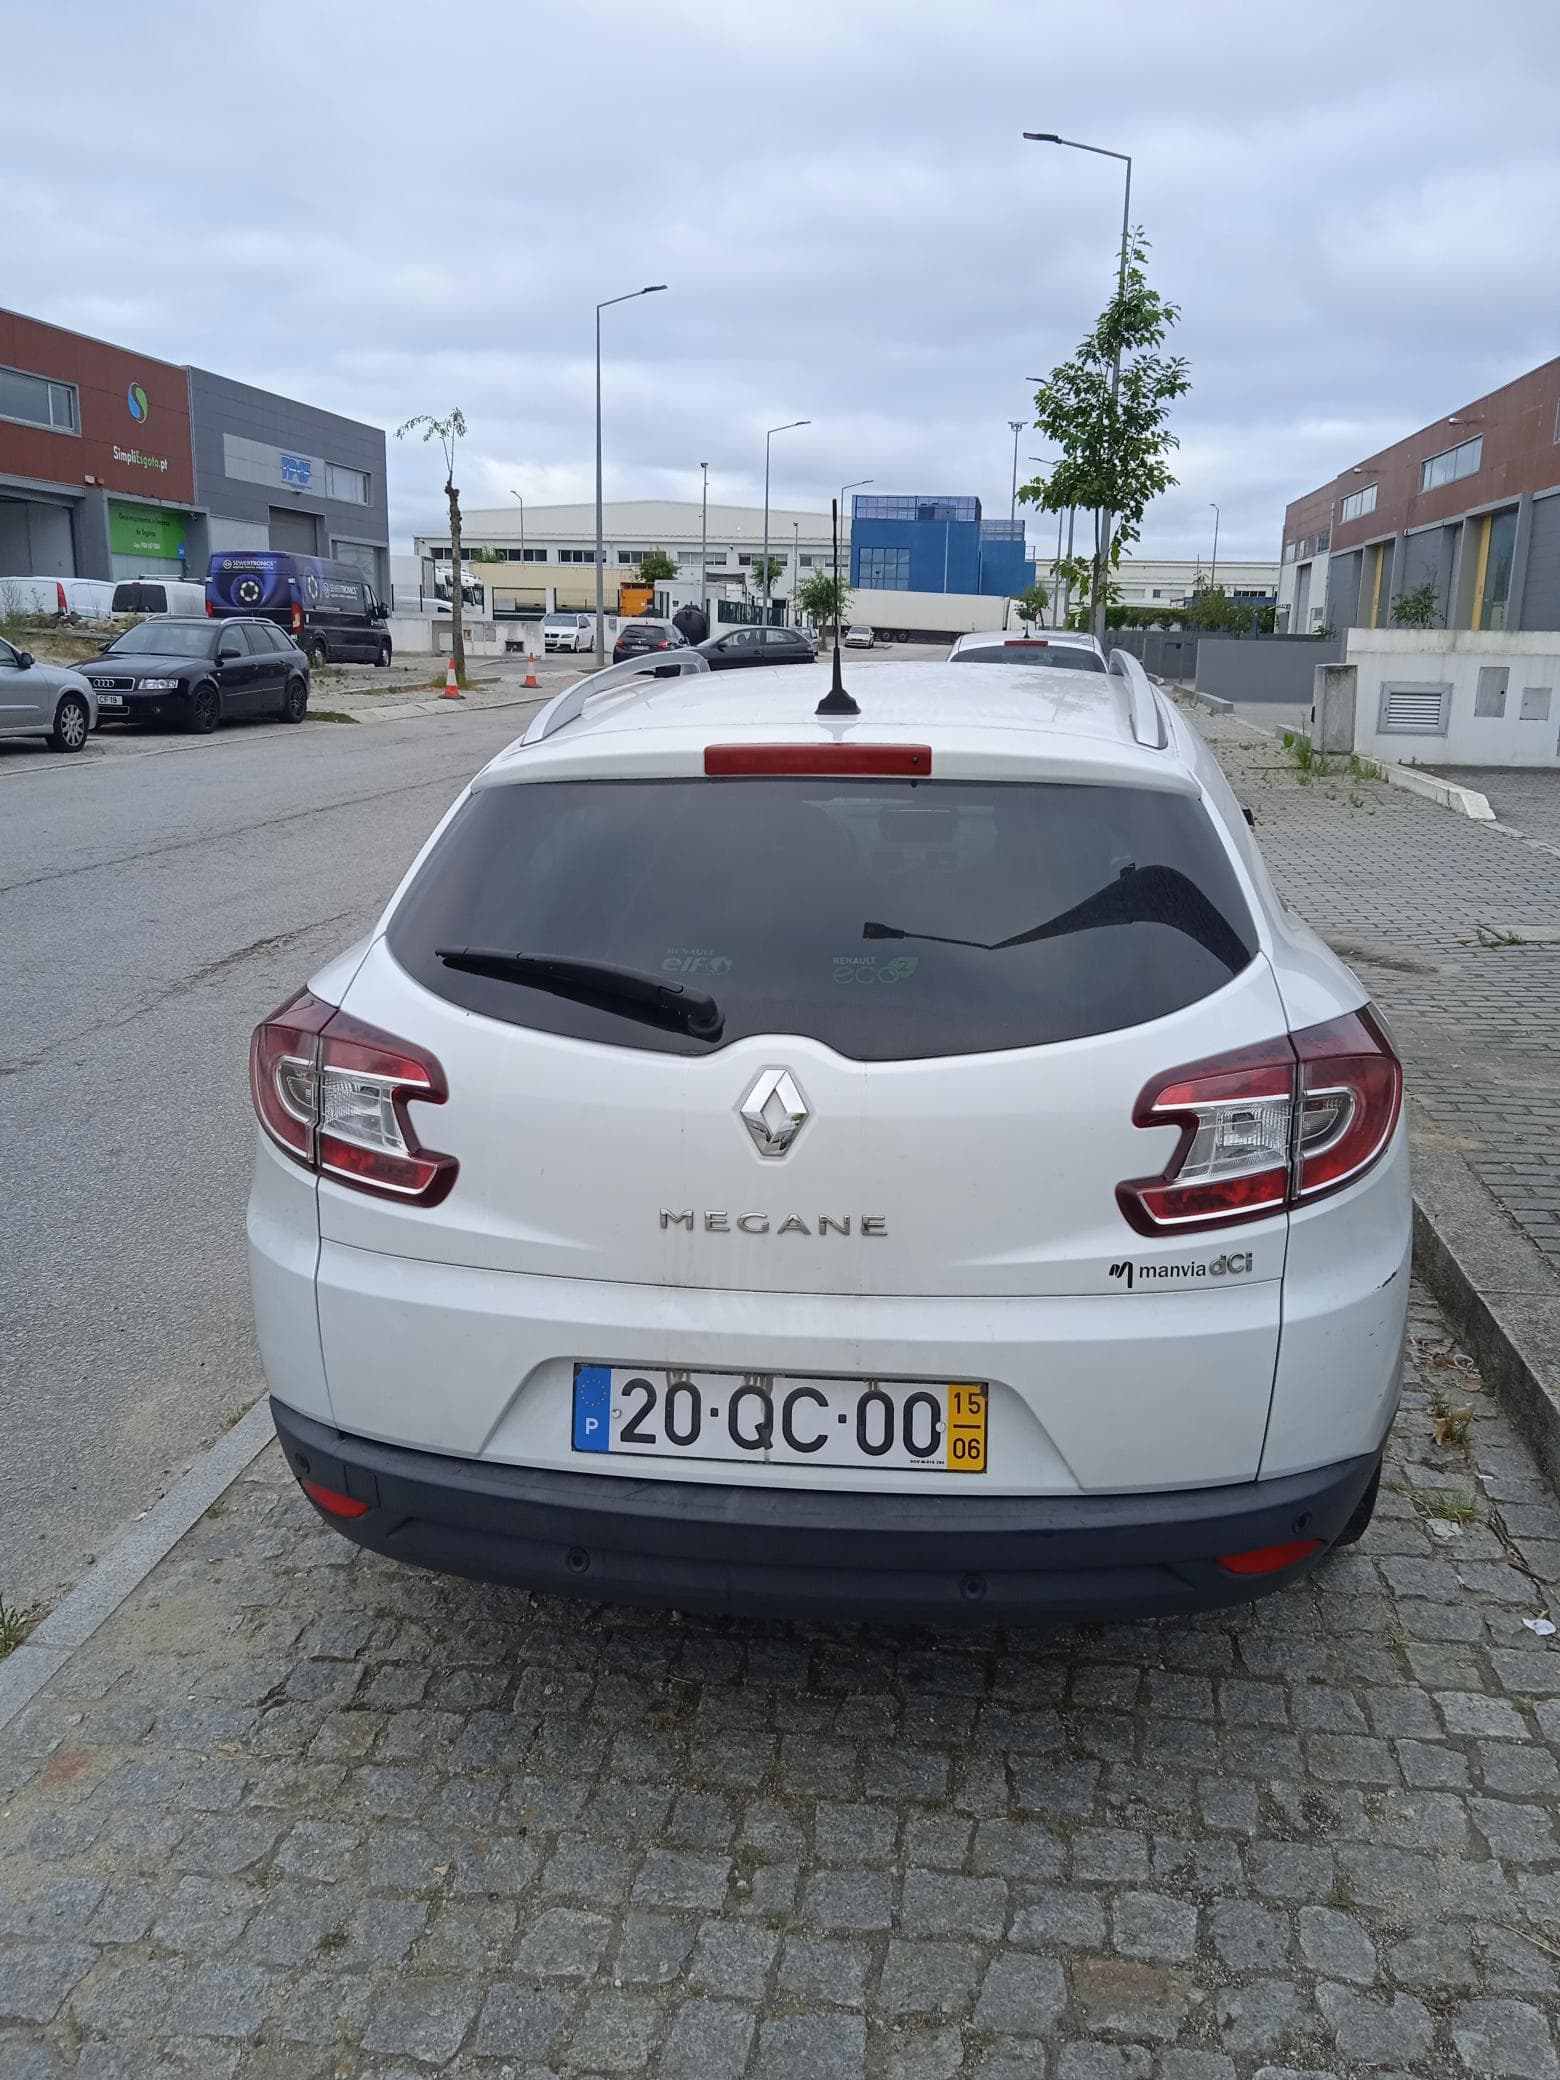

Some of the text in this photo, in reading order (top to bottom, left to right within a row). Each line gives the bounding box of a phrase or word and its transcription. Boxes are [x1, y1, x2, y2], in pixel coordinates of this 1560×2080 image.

[833, 957, 876, 965] RENAULT
[660, 1208, 889, 1236] MEGANE
[1139, 1261, 1207, 1279] manvia
[1209, 1252, 1254, 1276] dCi
[953, 1391, 982, 1415] 15
[585, 1417, 599, 1435] P
[953, 1437, 981, 1460] 06
